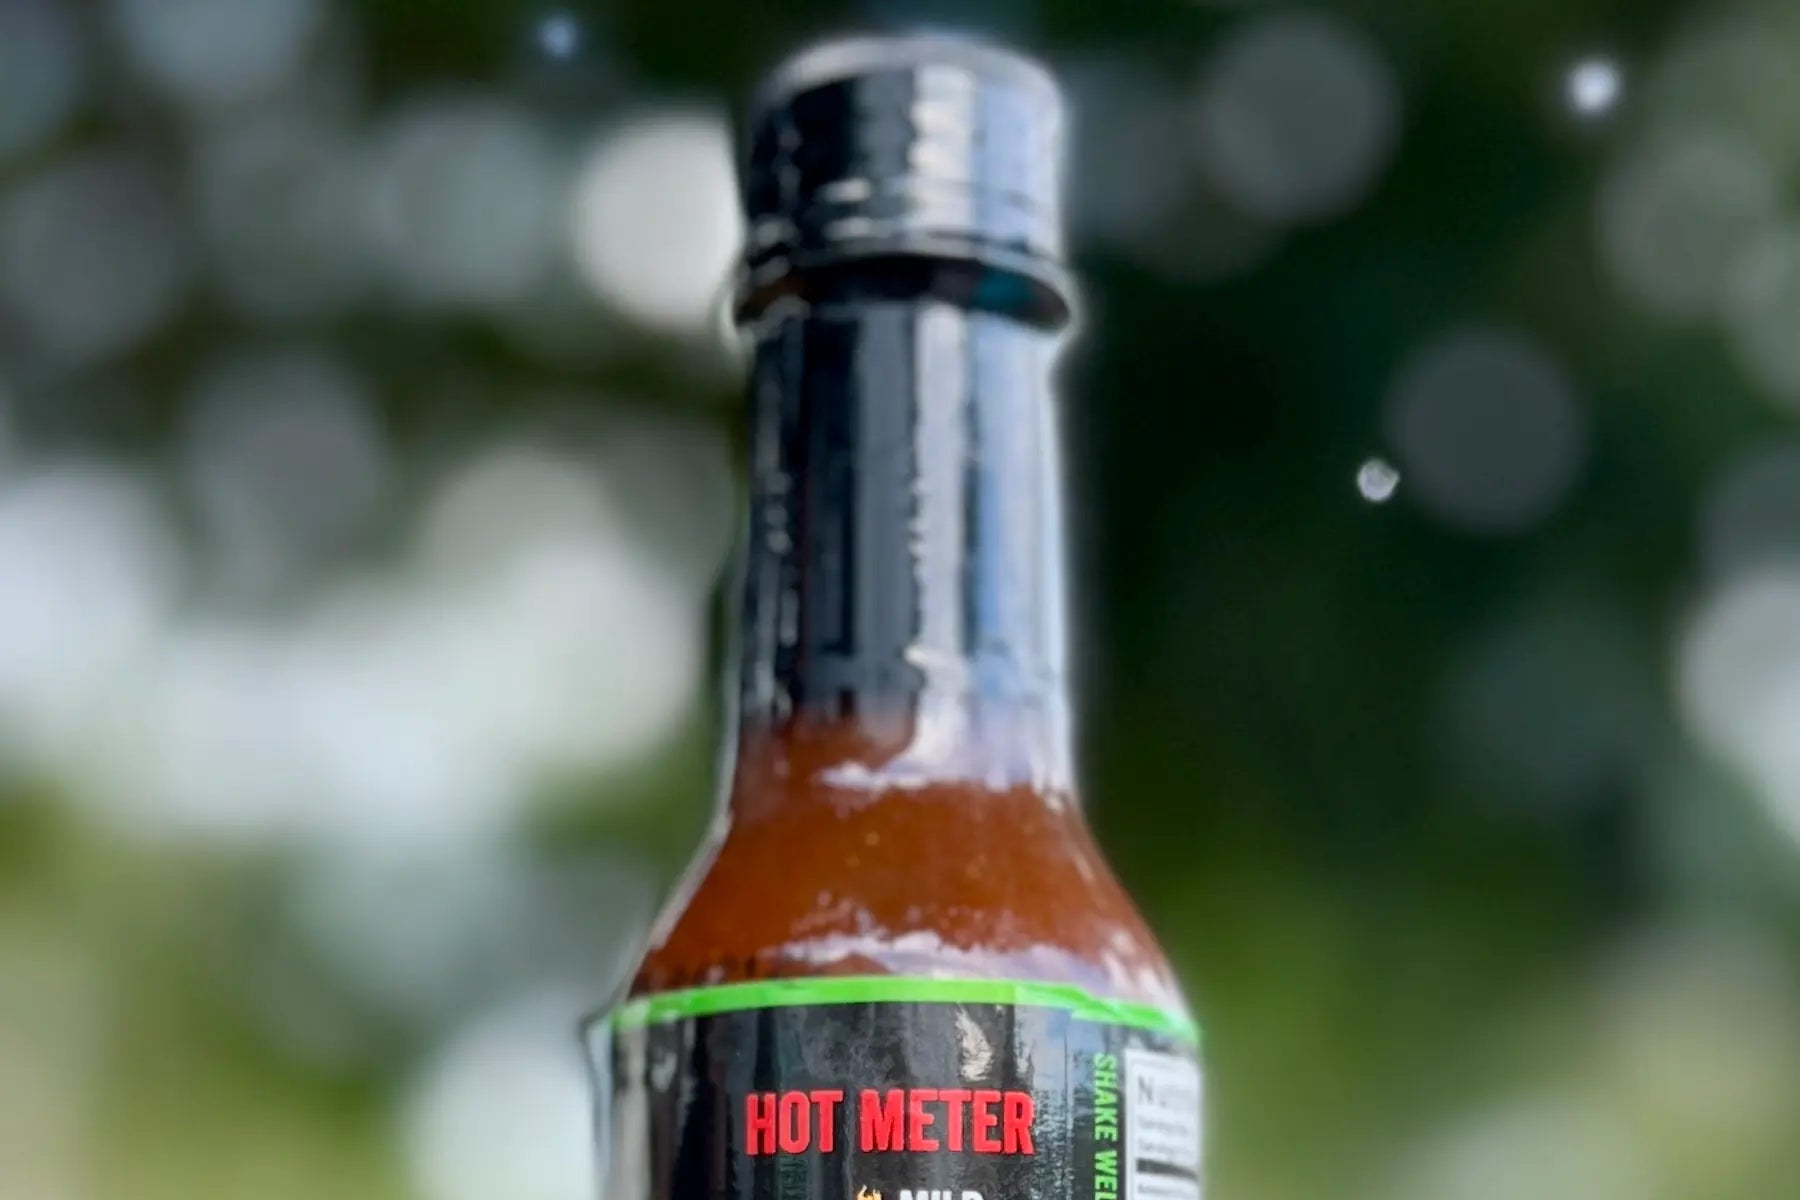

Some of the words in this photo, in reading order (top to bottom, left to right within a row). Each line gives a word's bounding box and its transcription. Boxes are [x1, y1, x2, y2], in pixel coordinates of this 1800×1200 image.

[745, 1089, 844, 1156] HOT
[858, 1088, 1035, 1156] METER
[1094, 1055, 1118, 1141] SHAKE
